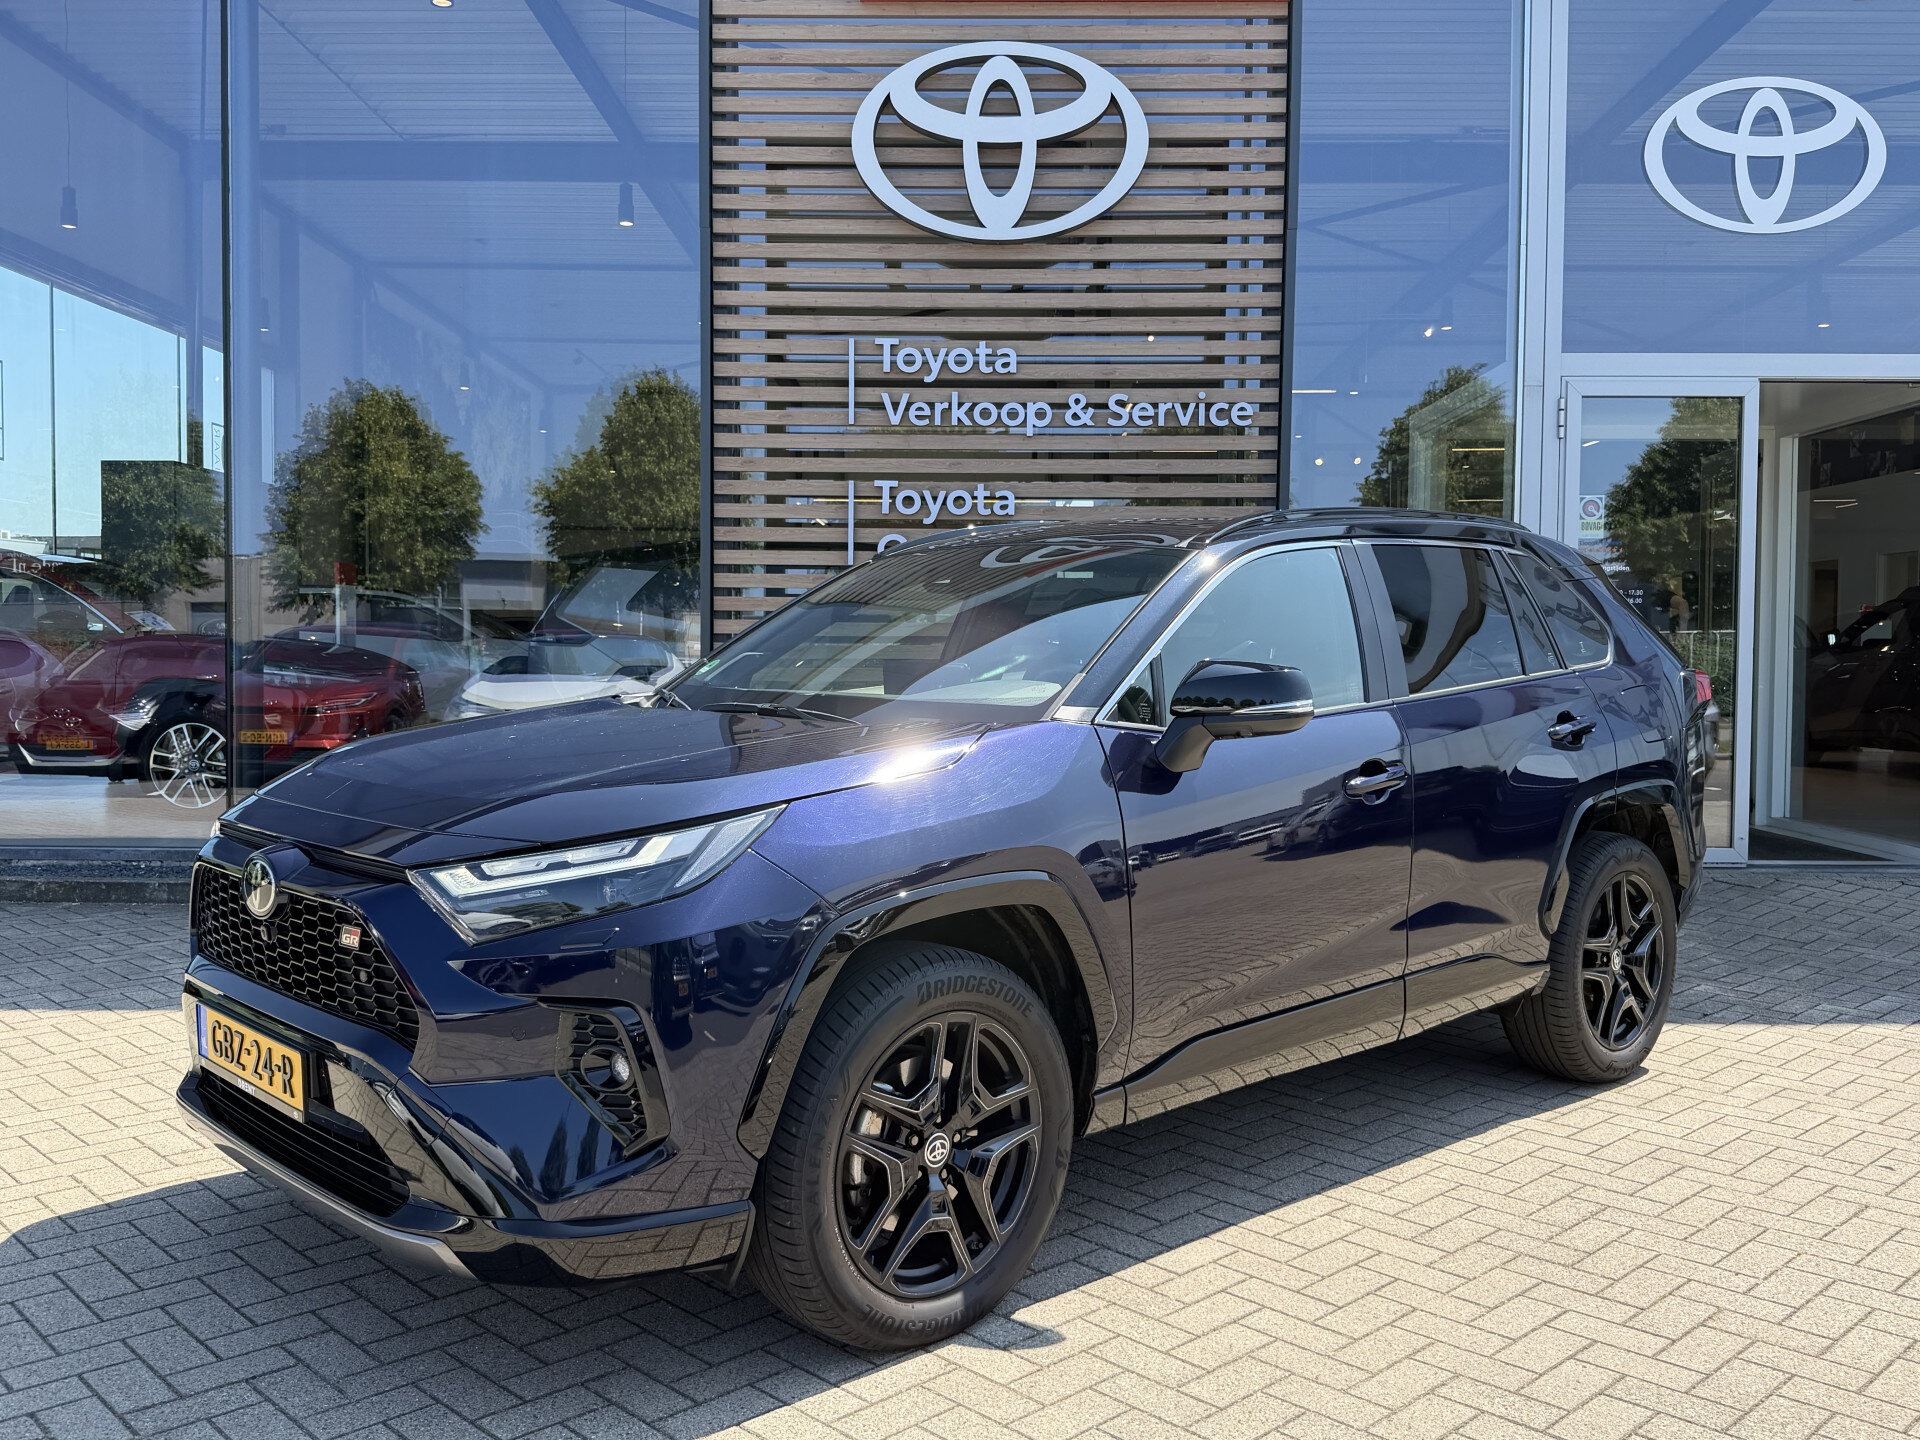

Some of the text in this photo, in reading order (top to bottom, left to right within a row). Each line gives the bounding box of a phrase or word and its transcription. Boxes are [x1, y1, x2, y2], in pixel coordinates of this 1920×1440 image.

[874, 337, 1018, 383] Toyota
[880, 391, 1254, 437] Verkoop & Service
[873, 479, 1016, 525] Toyota
[1581, 521, 1601, 531] BOVAG
[343, 933, 358, 946] GR
[916, 974, 1034, 1019] BRIDGESTONE
[211, 1020, 295, 1098] GBZ-24-R
